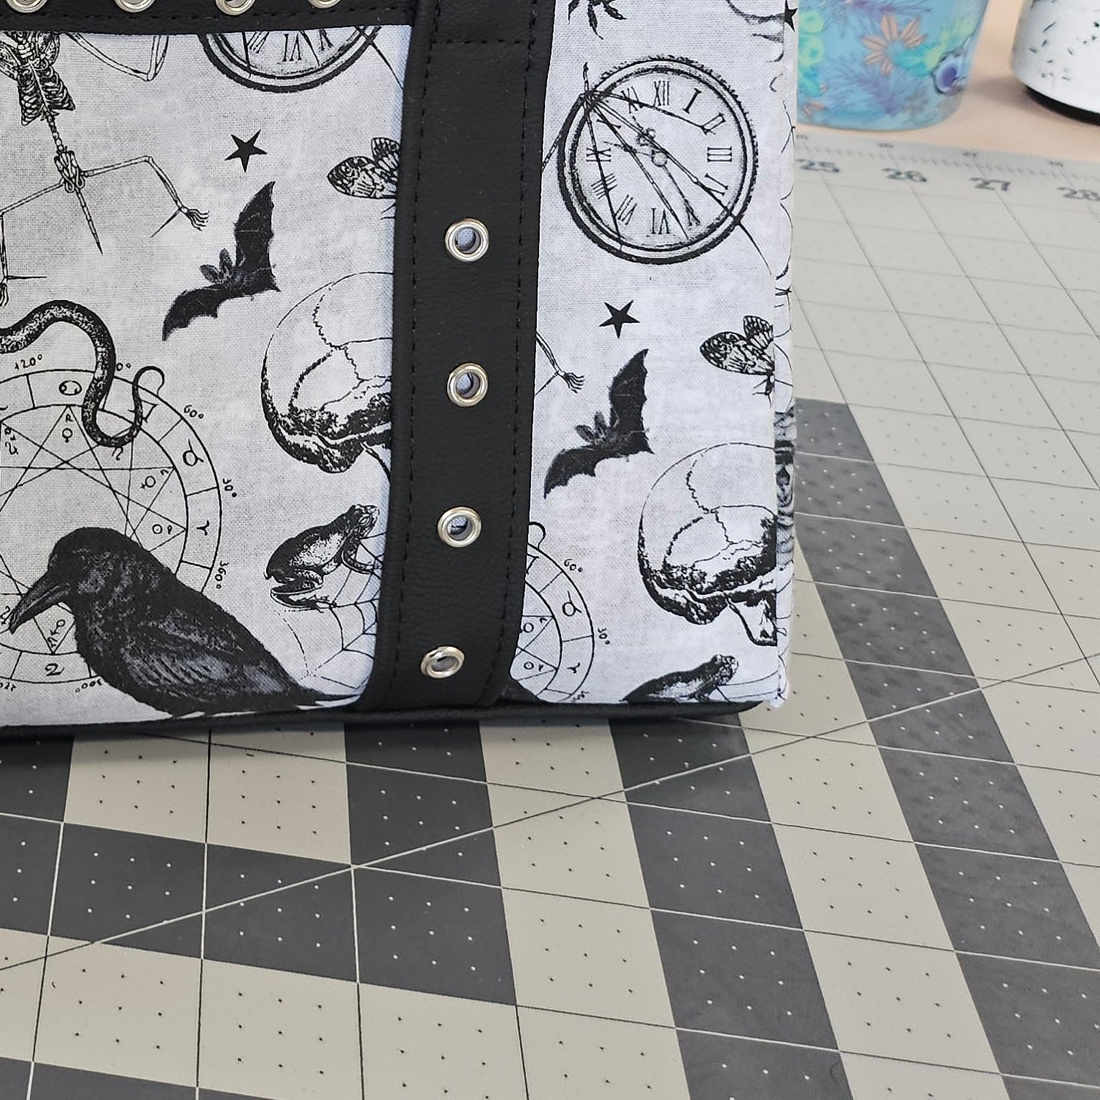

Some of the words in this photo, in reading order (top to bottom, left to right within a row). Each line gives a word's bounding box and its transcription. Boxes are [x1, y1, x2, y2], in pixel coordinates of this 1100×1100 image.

[795, 157, 841, 174] 25
[880, 166, 928, 184] 26
[968, 176, 1012, 193] 27
[1055, 185, 1100, 202] 28
[115, 362, 132, 372] 0°
